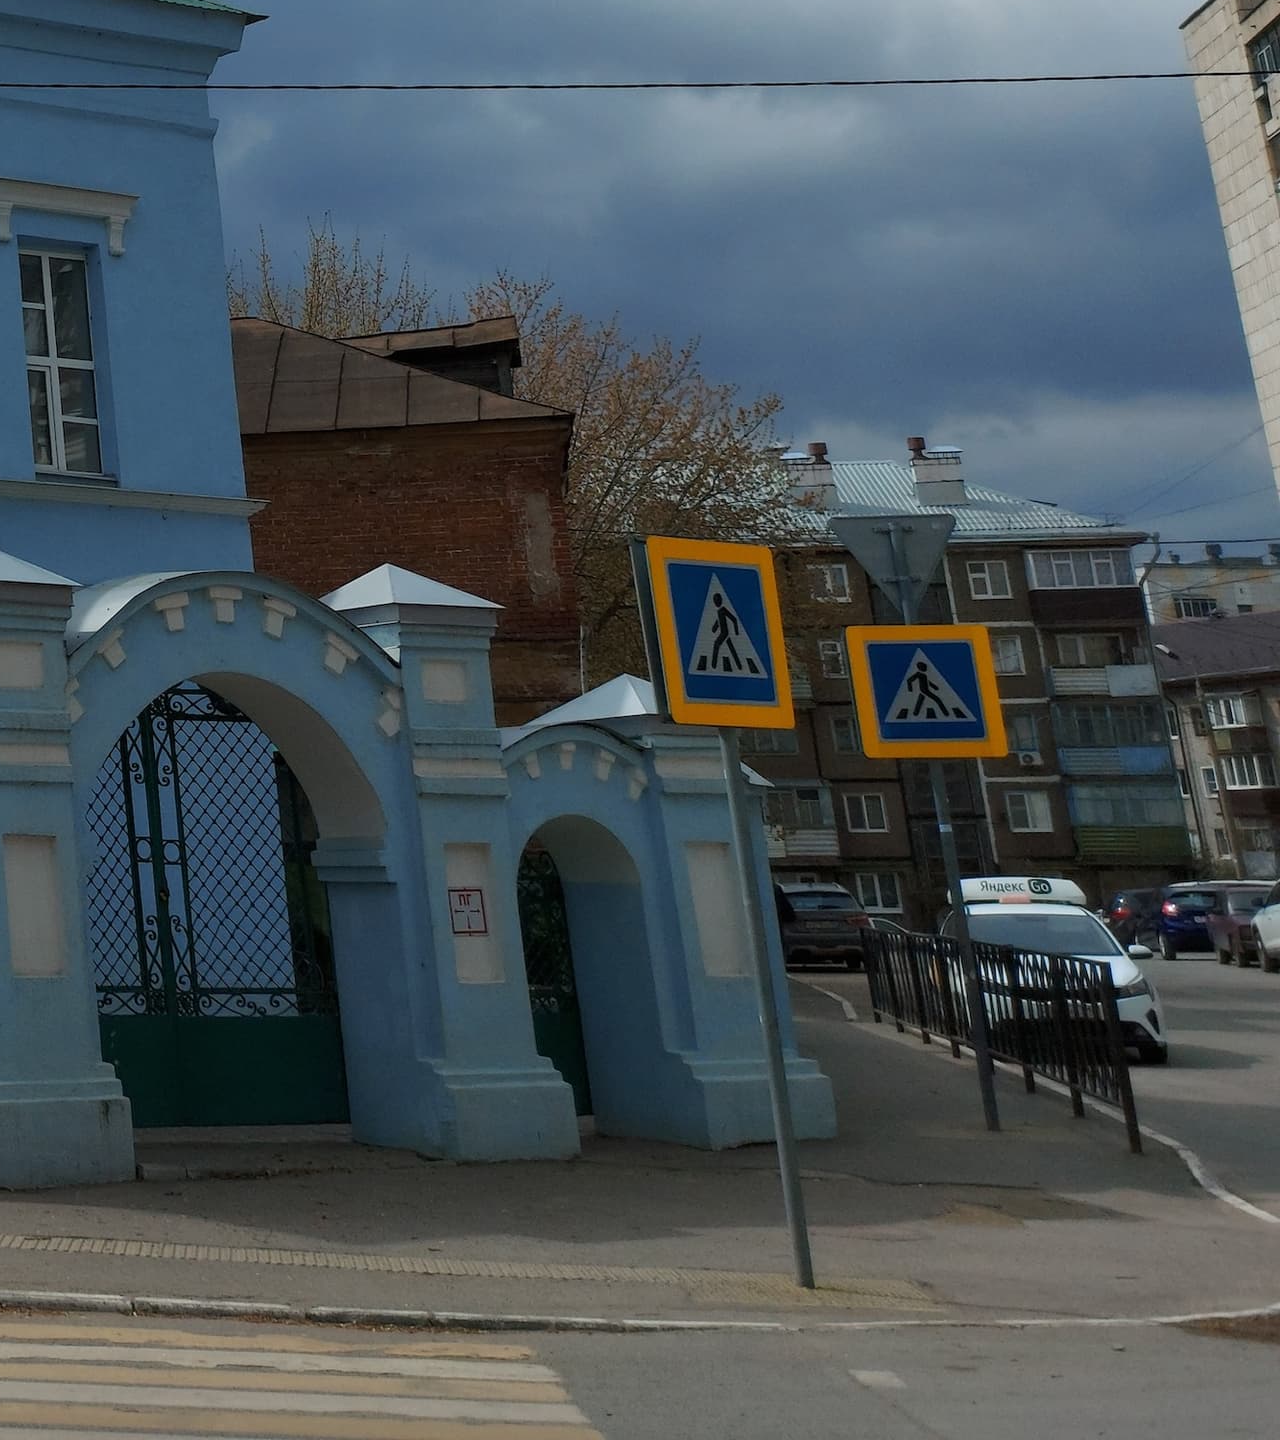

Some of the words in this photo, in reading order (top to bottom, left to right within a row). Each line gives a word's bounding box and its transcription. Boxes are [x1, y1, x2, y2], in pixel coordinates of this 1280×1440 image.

[980, 880, 1026, 892] Яндекс
[1030, 880, 1050, 892] Go
[458, 894, 471, 905] ПГ
